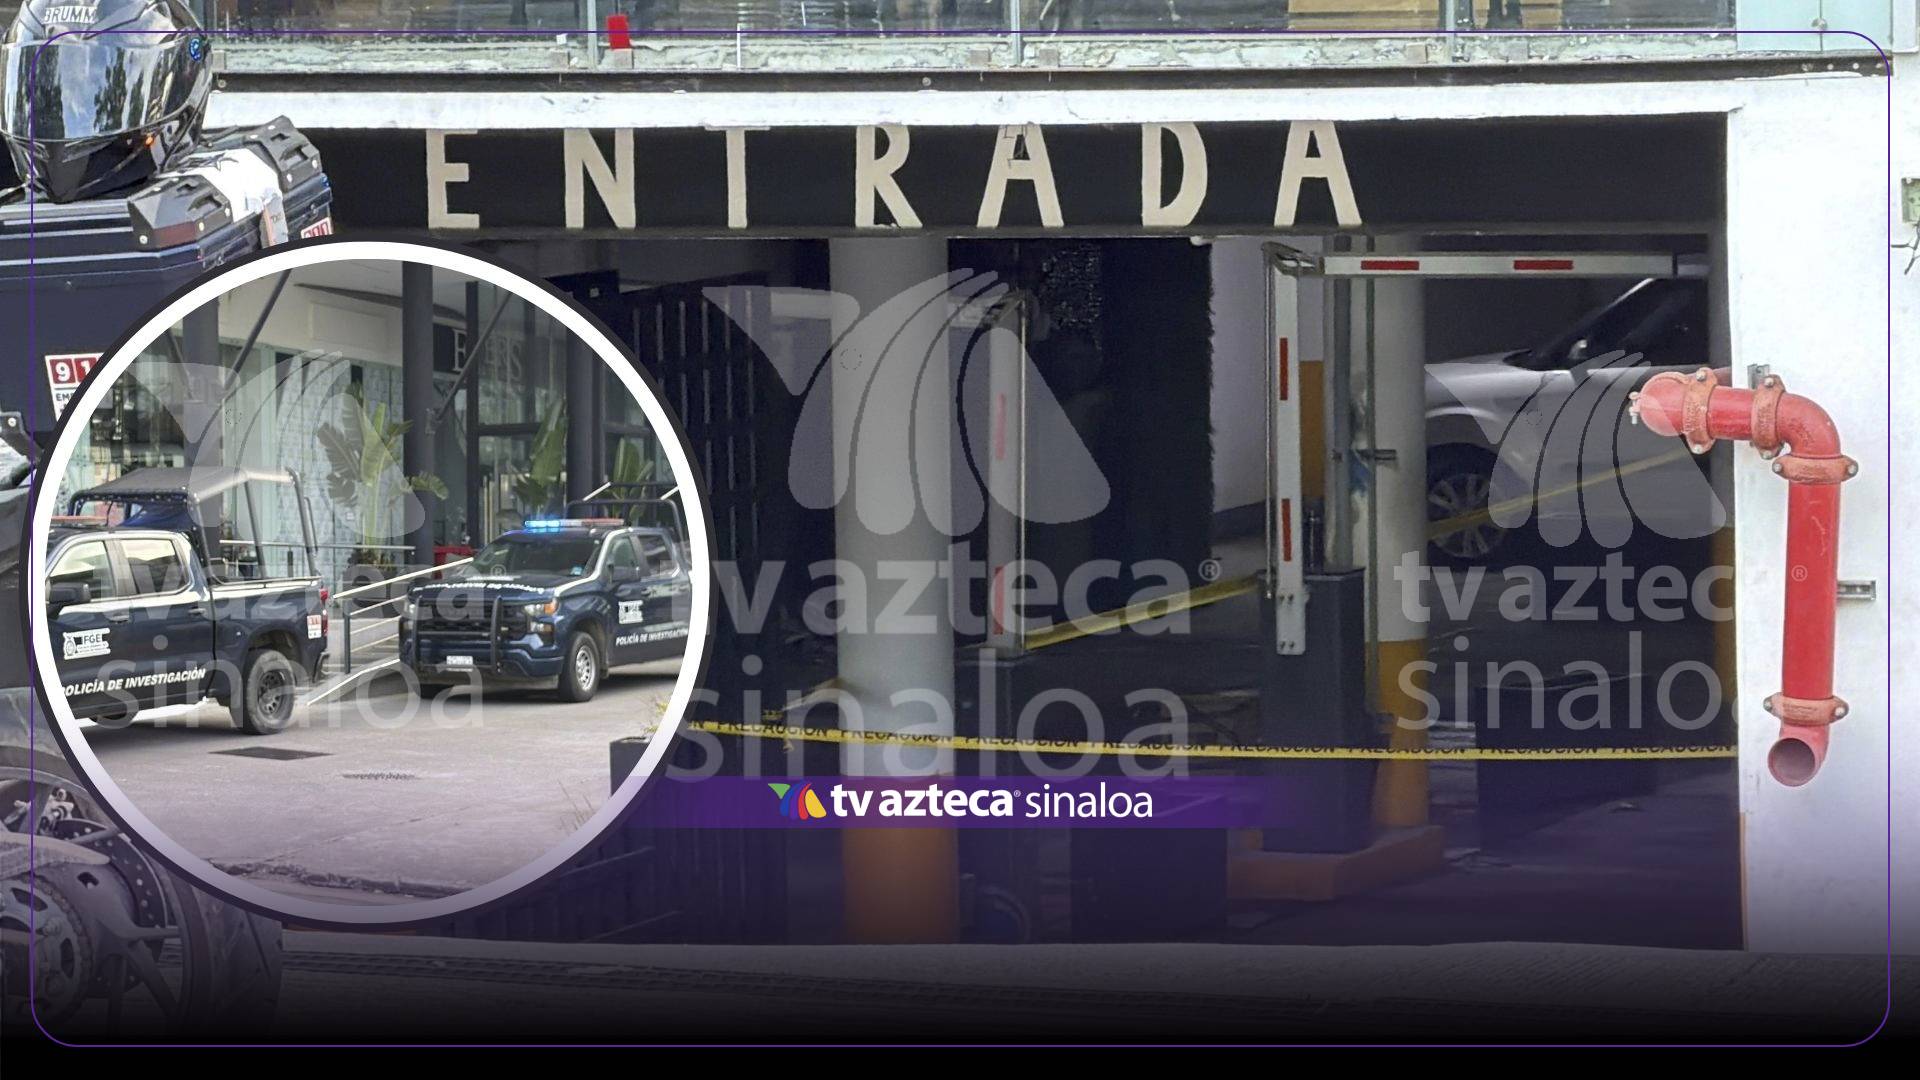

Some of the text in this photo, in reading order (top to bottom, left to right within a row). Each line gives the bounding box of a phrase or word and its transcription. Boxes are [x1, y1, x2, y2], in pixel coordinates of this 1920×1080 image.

[426, 119, 1362, 230] ENTRADA
[83, 633, 101, 645] FGE
[62, 667, 206, 697] OLICÍA DE INVESTIGACIÓN
